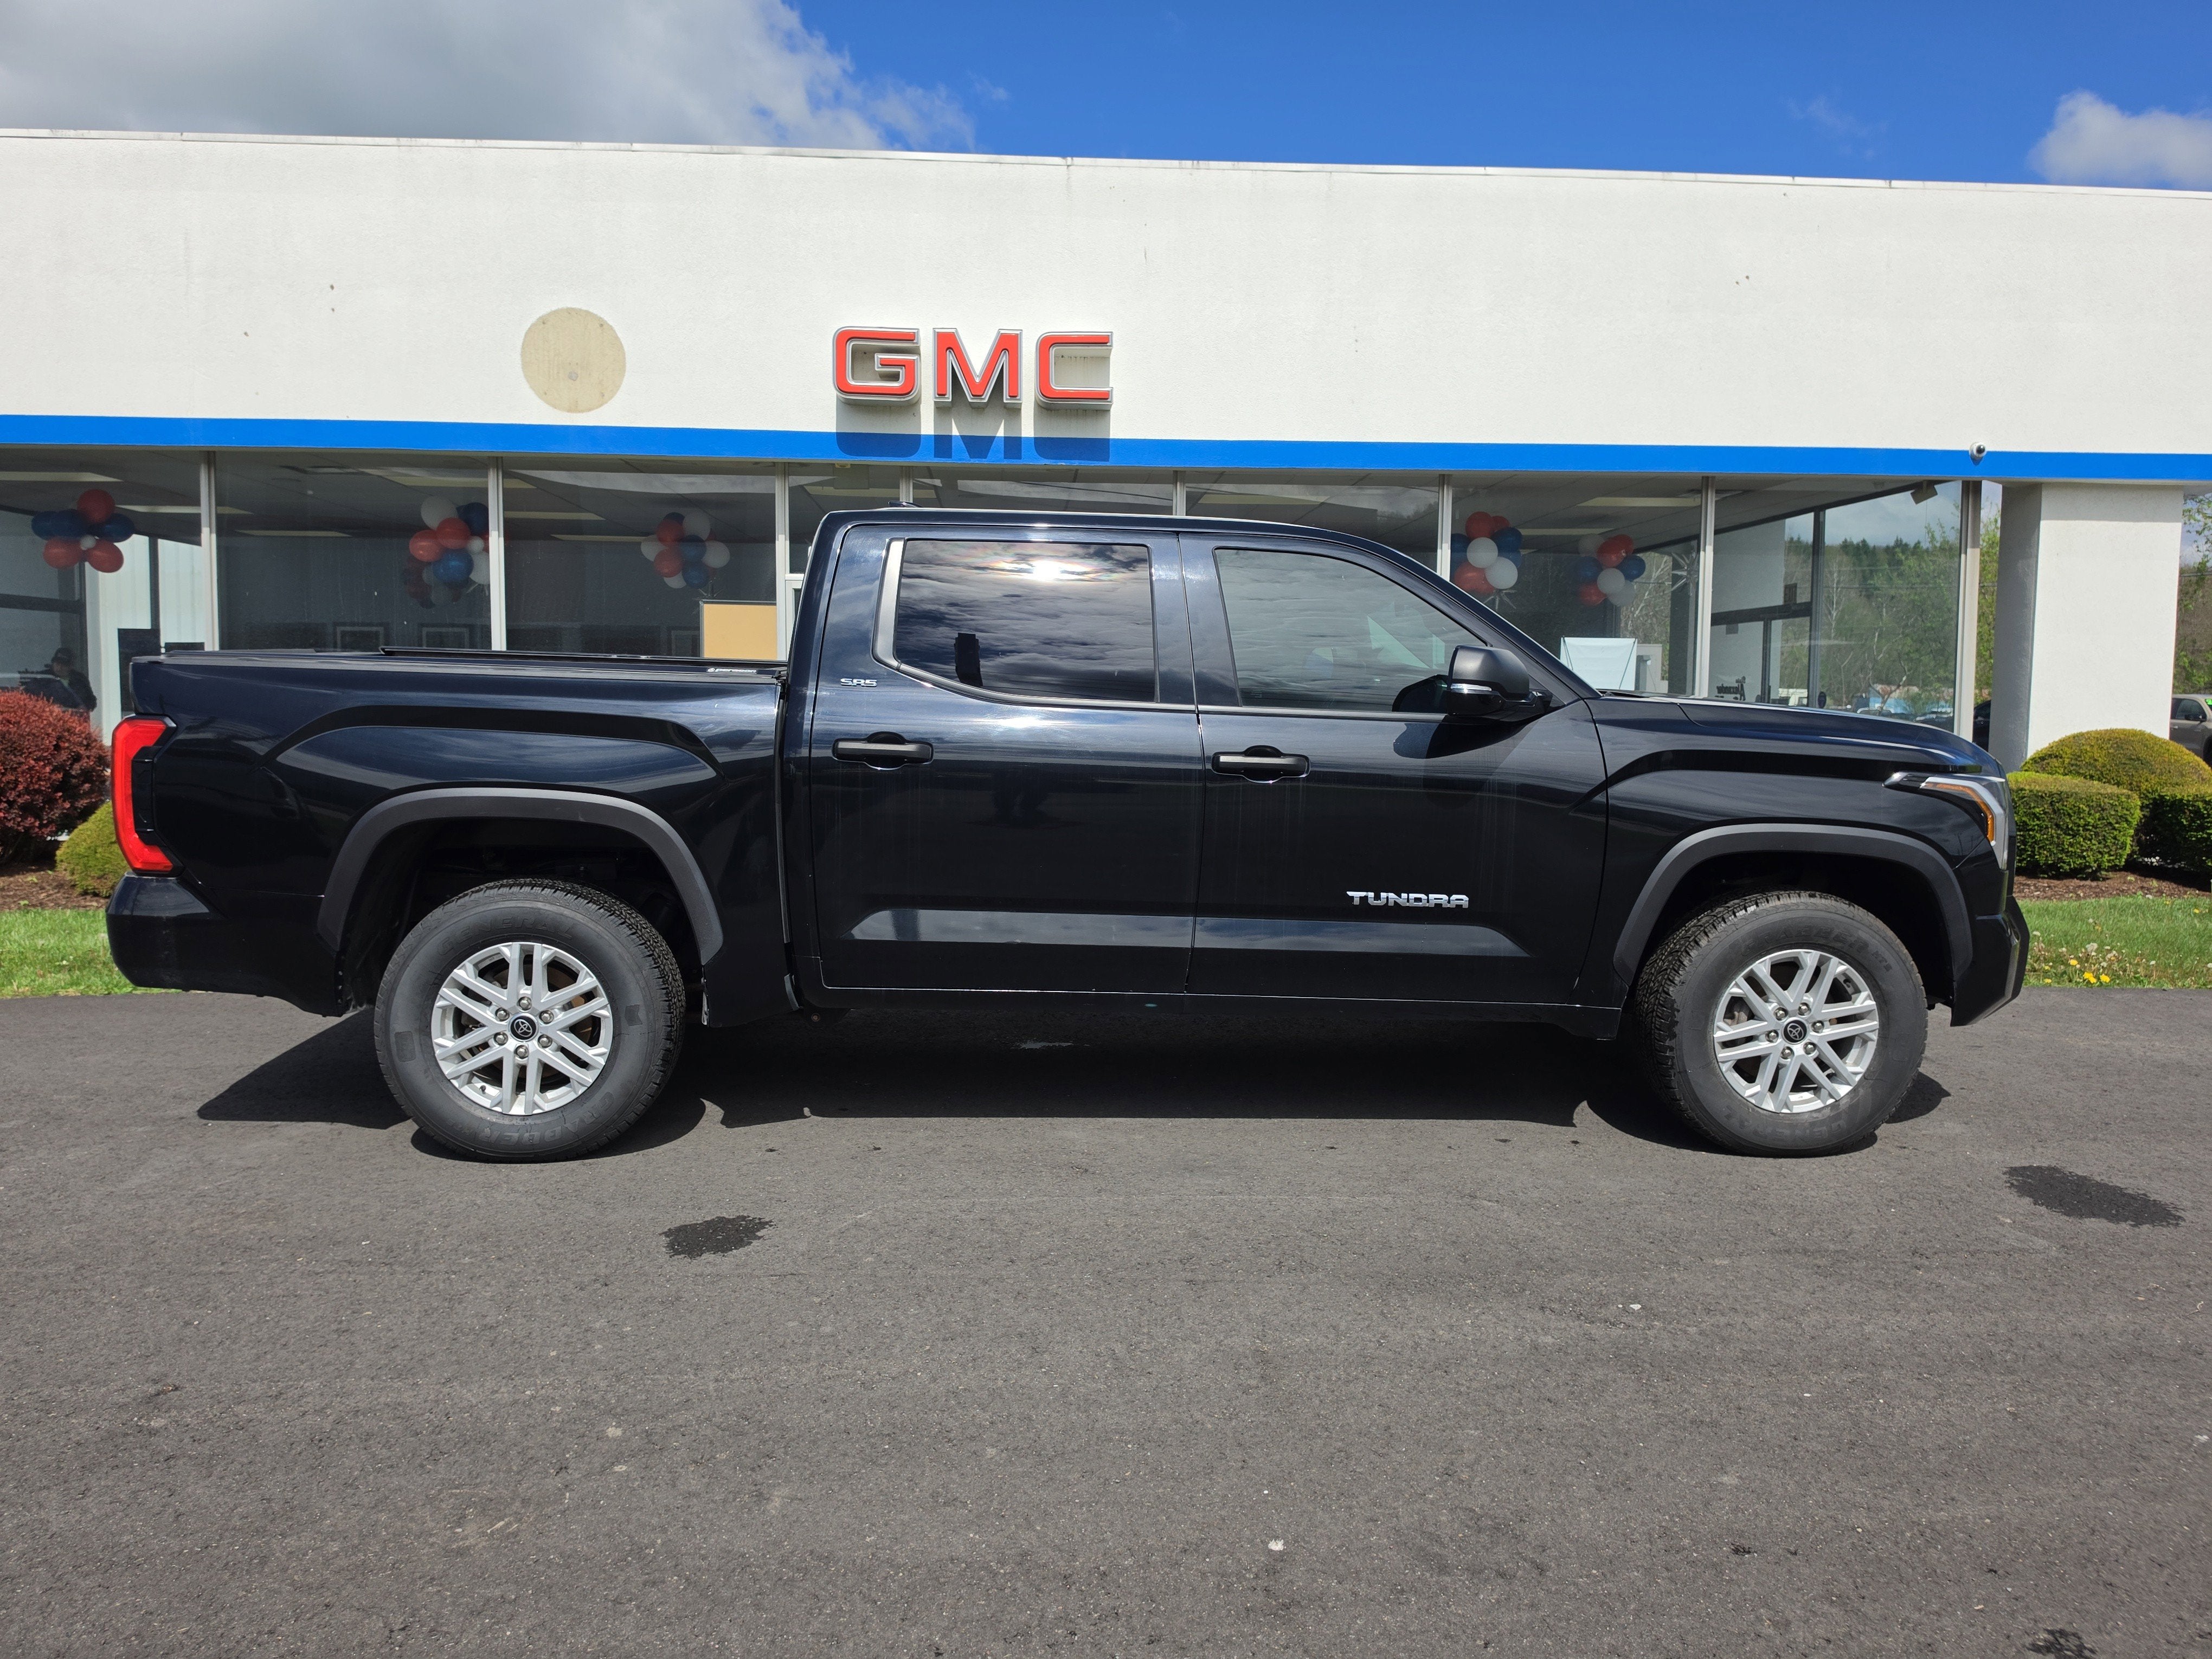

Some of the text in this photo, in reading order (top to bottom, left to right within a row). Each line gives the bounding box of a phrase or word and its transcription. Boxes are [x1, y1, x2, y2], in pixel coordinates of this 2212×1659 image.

[833, 326, 1114, 408] GMC
[840, 678, 877, 687] SR5
[1346, 891, 1469, 909] TUNDRA
[438, 916, 573, 956] GENERAL
